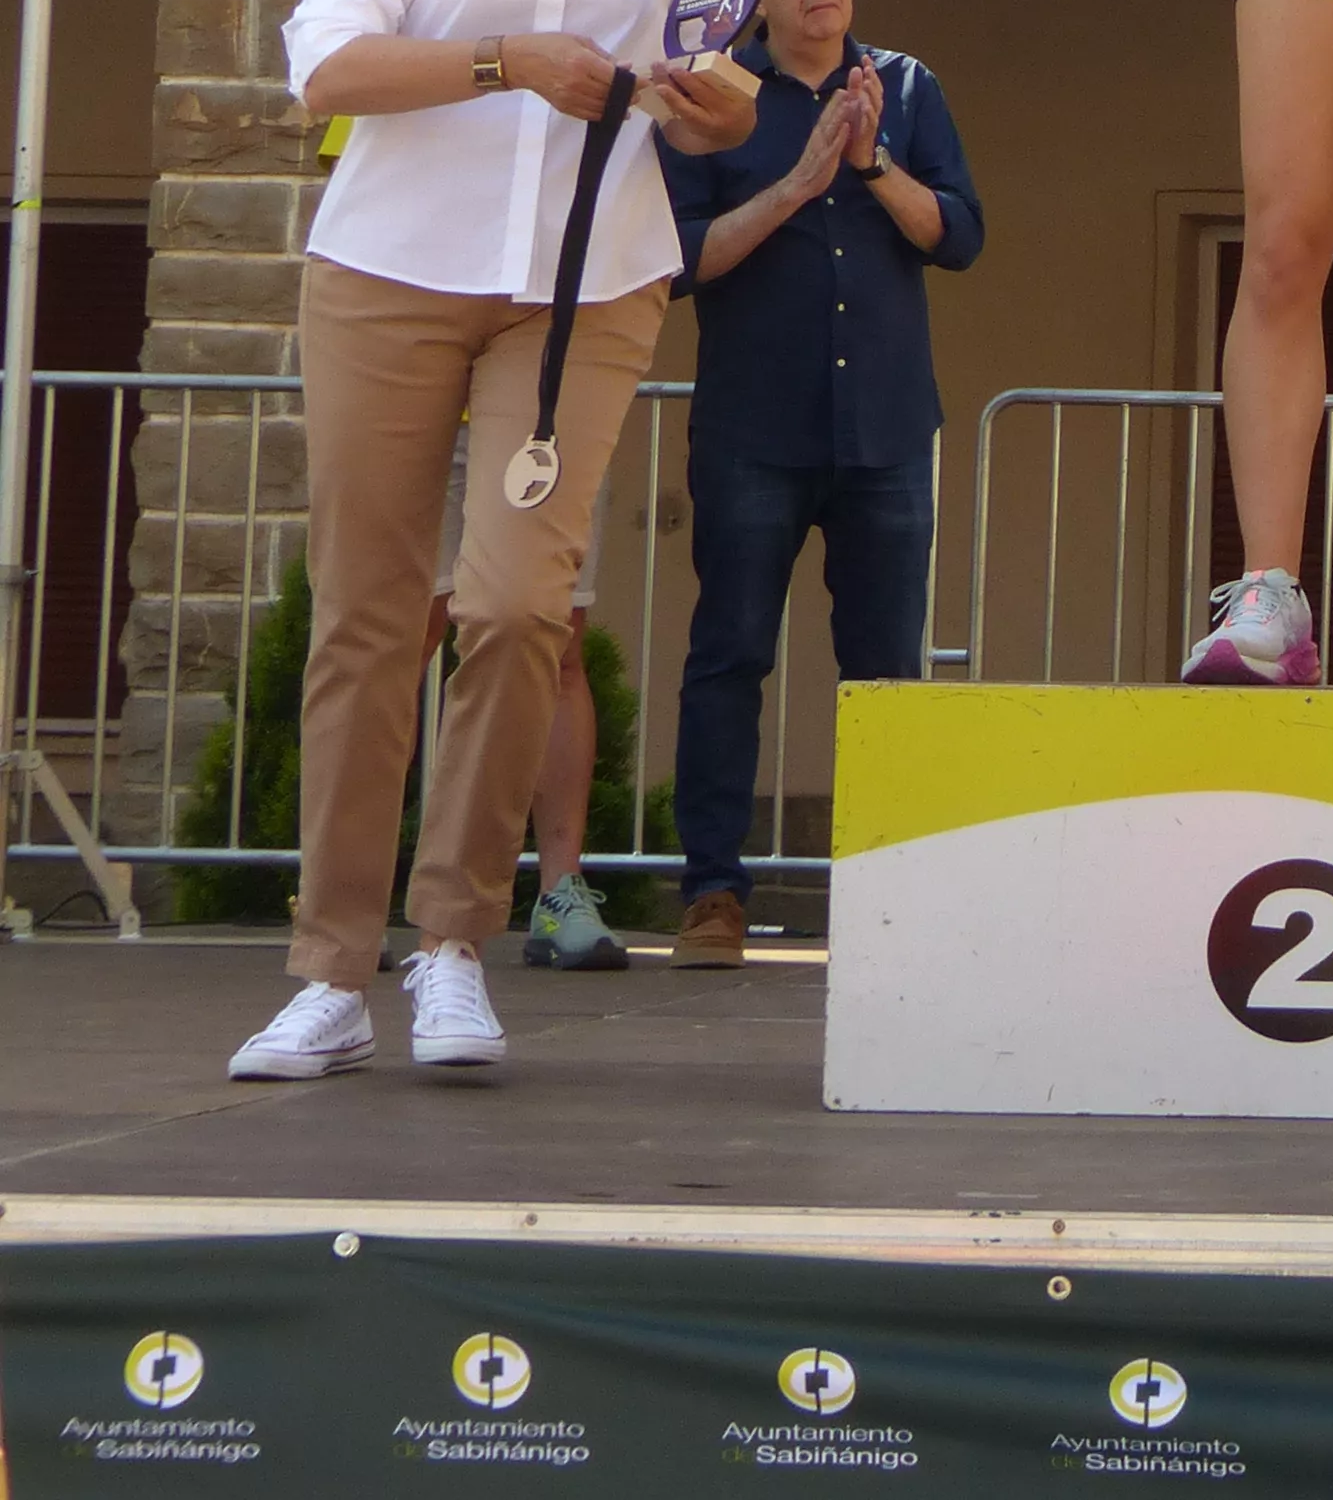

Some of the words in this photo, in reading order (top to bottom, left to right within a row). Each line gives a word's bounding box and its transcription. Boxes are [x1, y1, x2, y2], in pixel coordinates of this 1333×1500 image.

[62, 1417, 256, 1440] Ayuntamiento
[394, 1417, 585, 1442] Ayuntamiento
[722, 1422, 913, 1447] Ayuntamiento
[1051, 1433, 1240, 1458] Ayuntamiento
